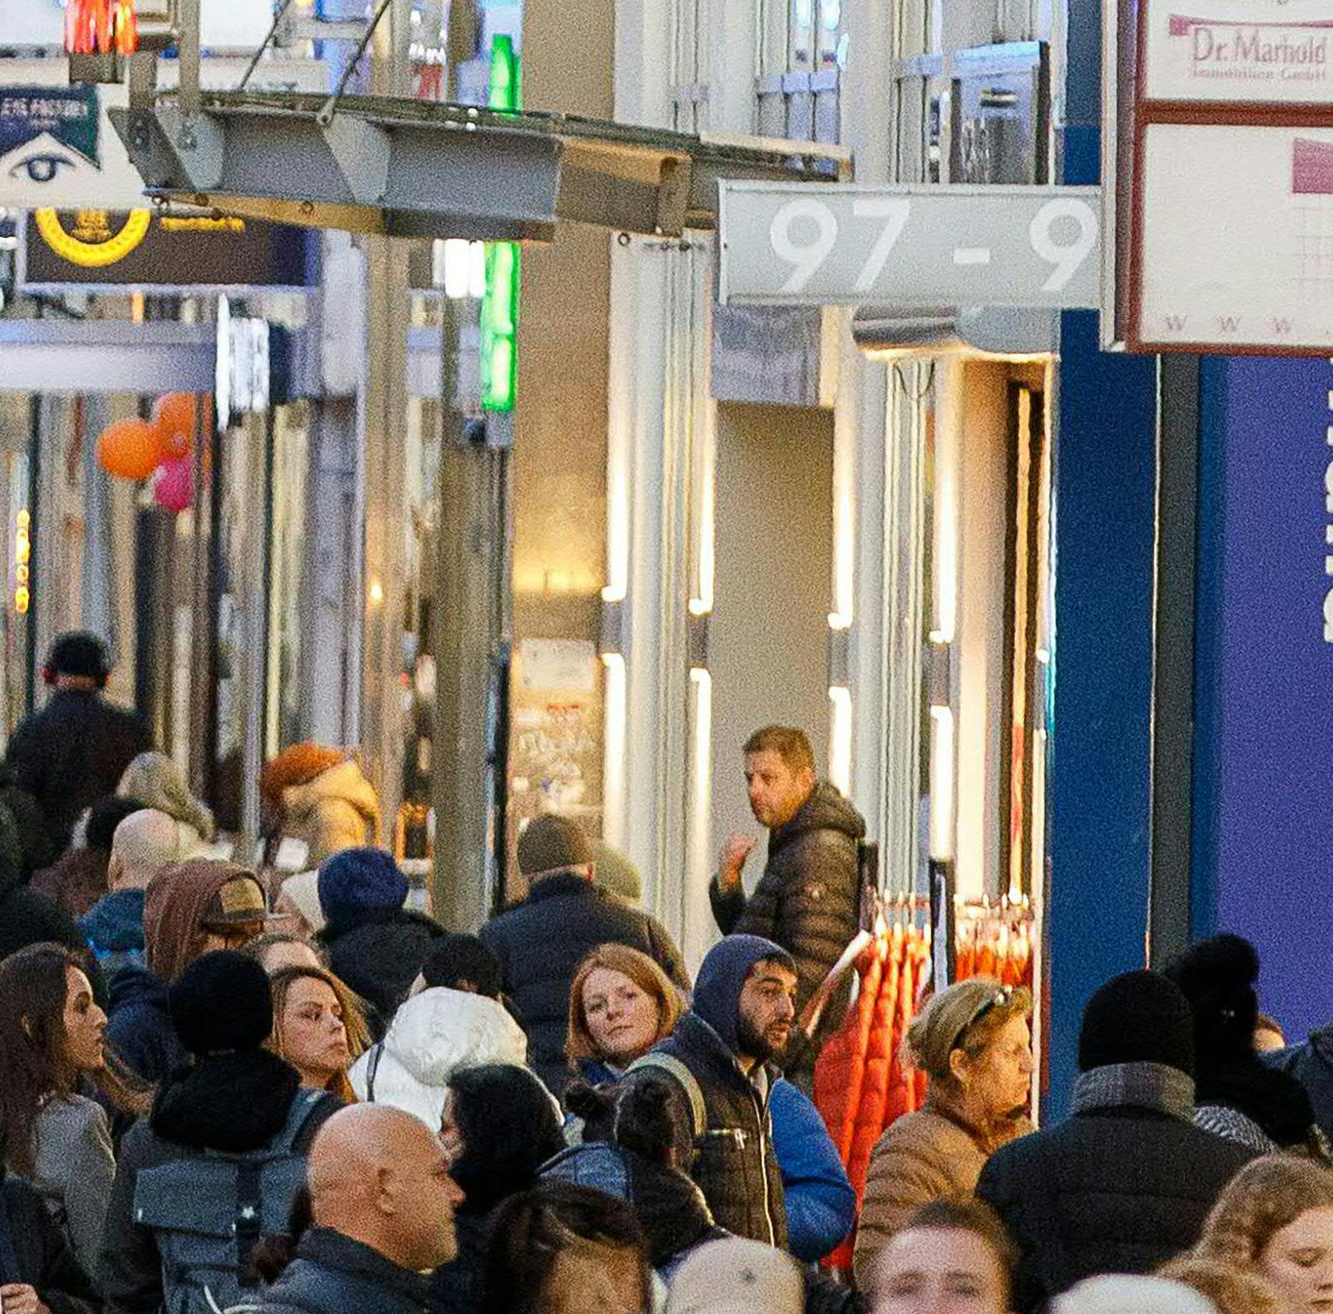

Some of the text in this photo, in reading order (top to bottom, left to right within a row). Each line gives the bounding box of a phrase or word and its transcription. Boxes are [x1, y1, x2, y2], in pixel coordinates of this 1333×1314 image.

[1193, 27, 1229, 62] Dr.
[770, 198, 910, 293] 97
[1029, 197, 1099, 292] 9
